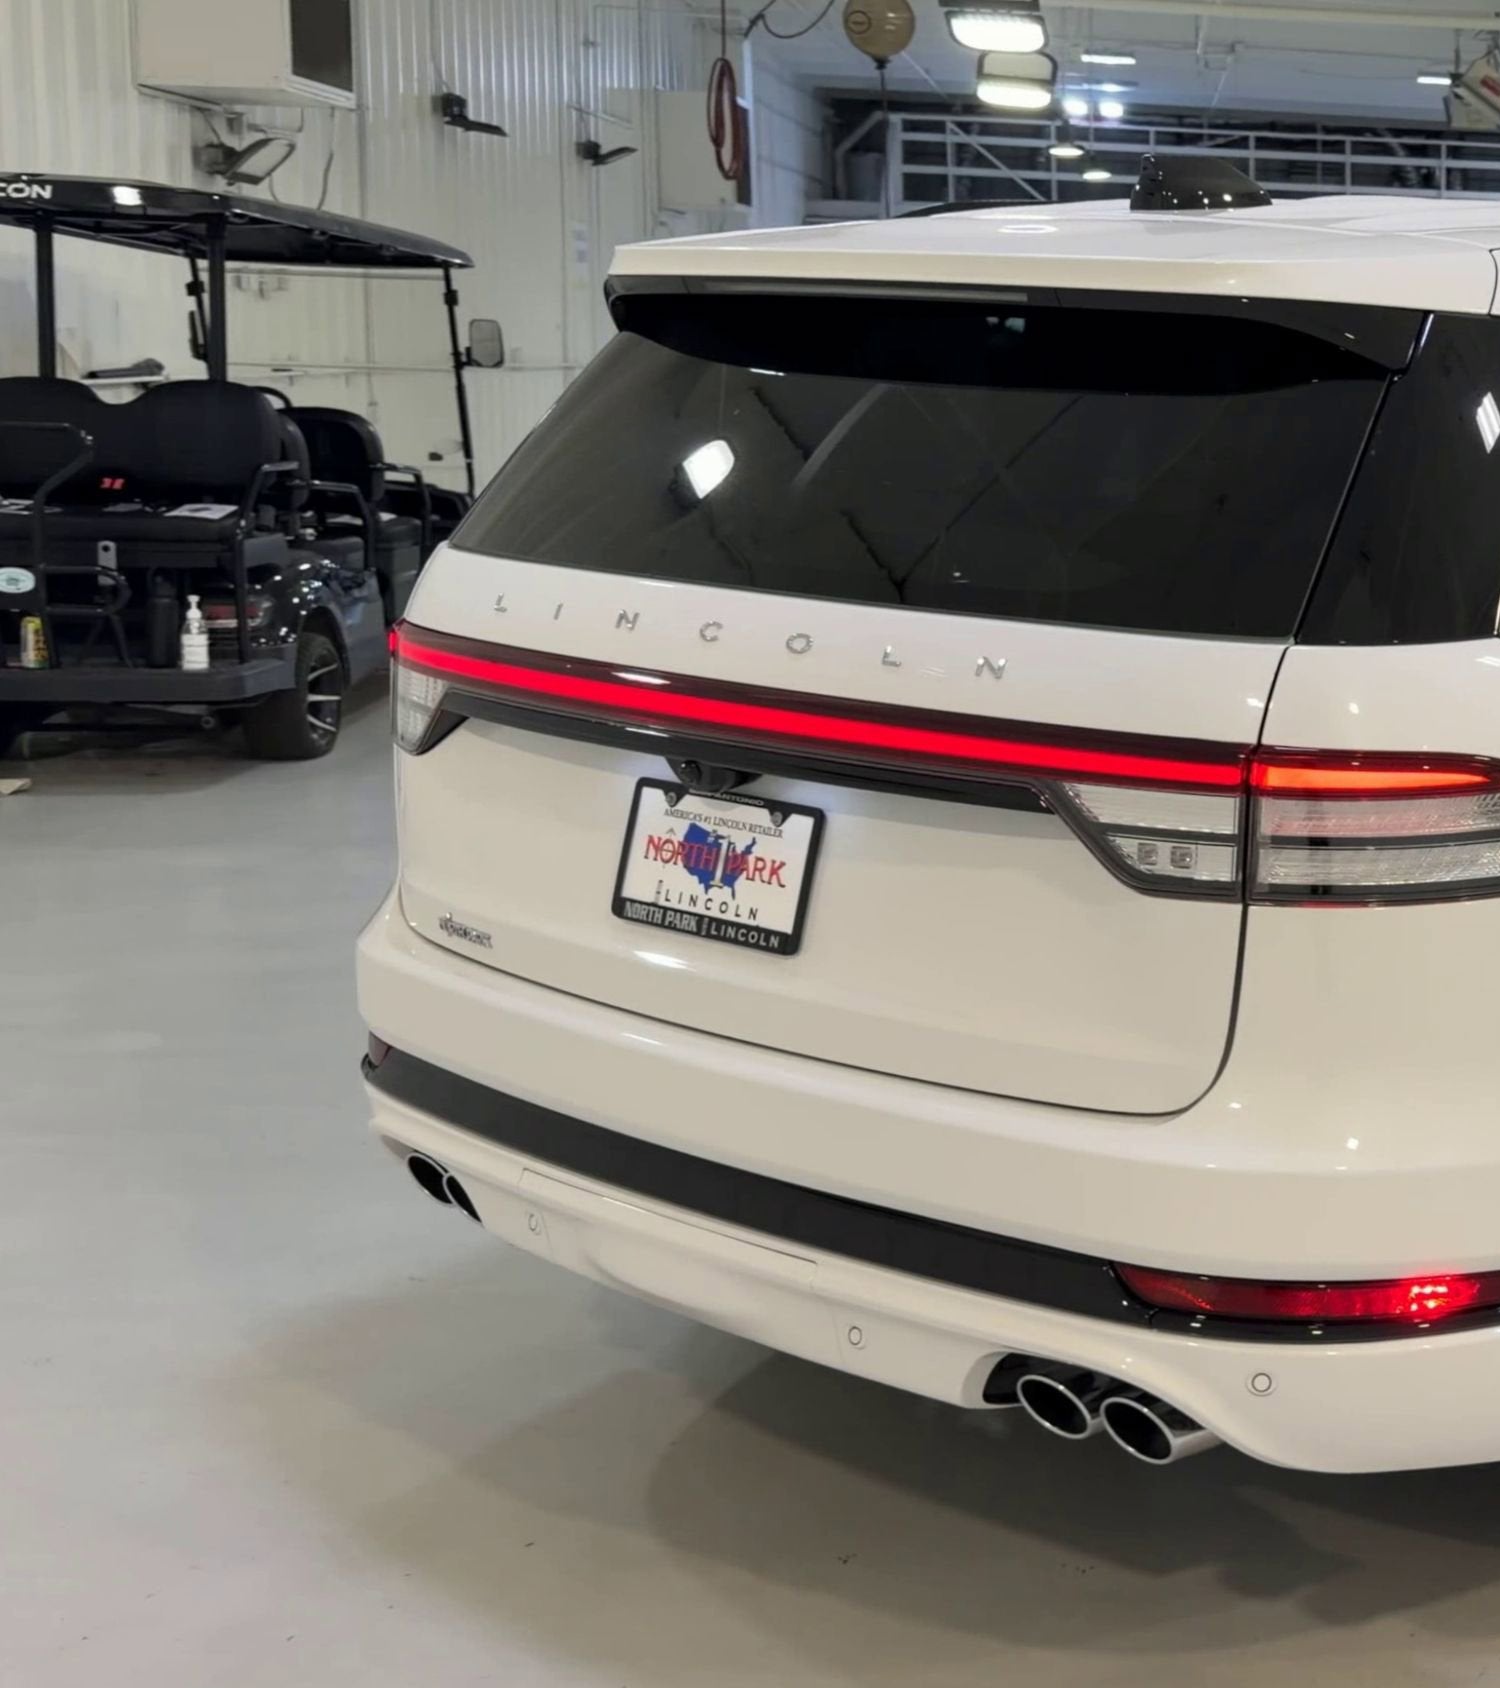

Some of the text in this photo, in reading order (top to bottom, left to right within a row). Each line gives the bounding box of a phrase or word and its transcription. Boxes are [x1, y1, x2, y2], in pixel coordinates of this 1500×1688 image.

[493, 592, 1008, 681] LINCOLN
[713, 816, 748, 833] LINCOLN
[748, 822, 784, 839] RETAILER
[643, 835, 787, 888] NORTH PARK
[623, 901, 663, 926] NORTH
[664, 909, 699, 933] PARK
[709, 922, 780, 949] LINCOLN
[664, 888, 758, 921] LINCOLN
